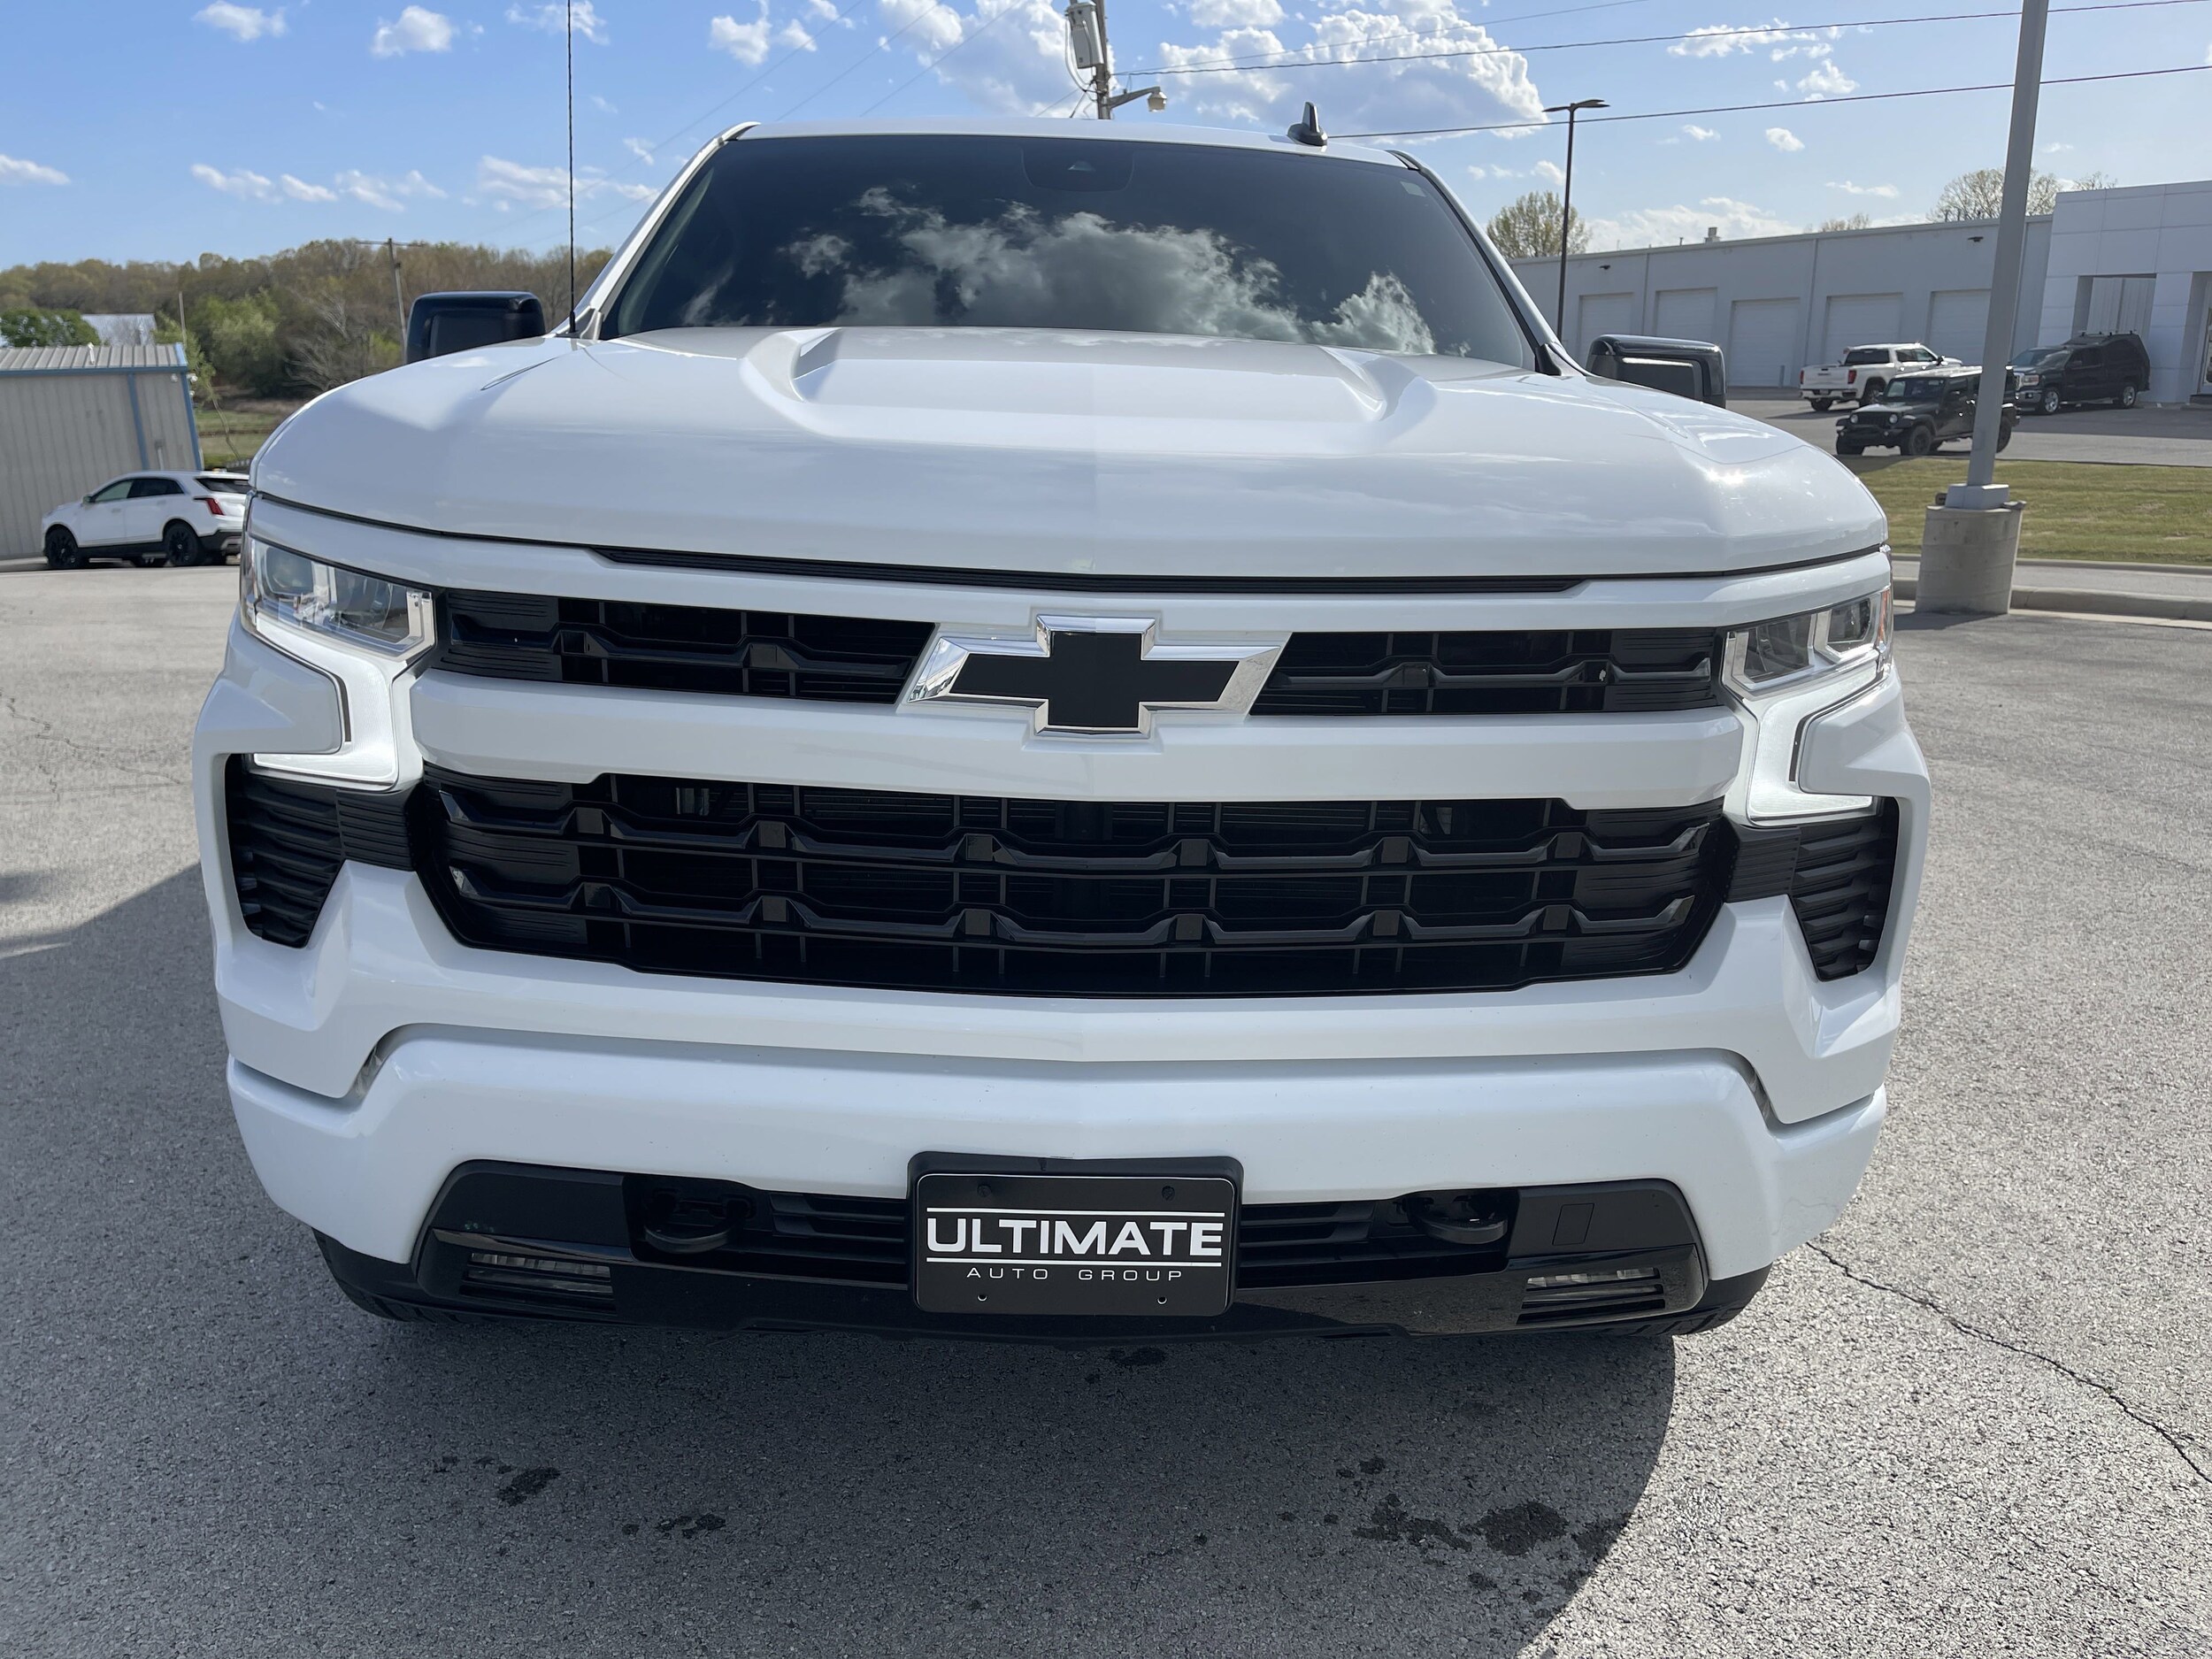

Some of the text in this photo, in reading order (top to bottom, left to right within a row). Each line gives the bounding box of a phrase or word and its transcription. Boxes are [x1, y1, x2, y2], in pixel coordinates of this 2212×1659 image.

[927, 1218, 1224, 1256] ULTIMATE
[966, 1267, 1182, 1281] AUTO GROUP
